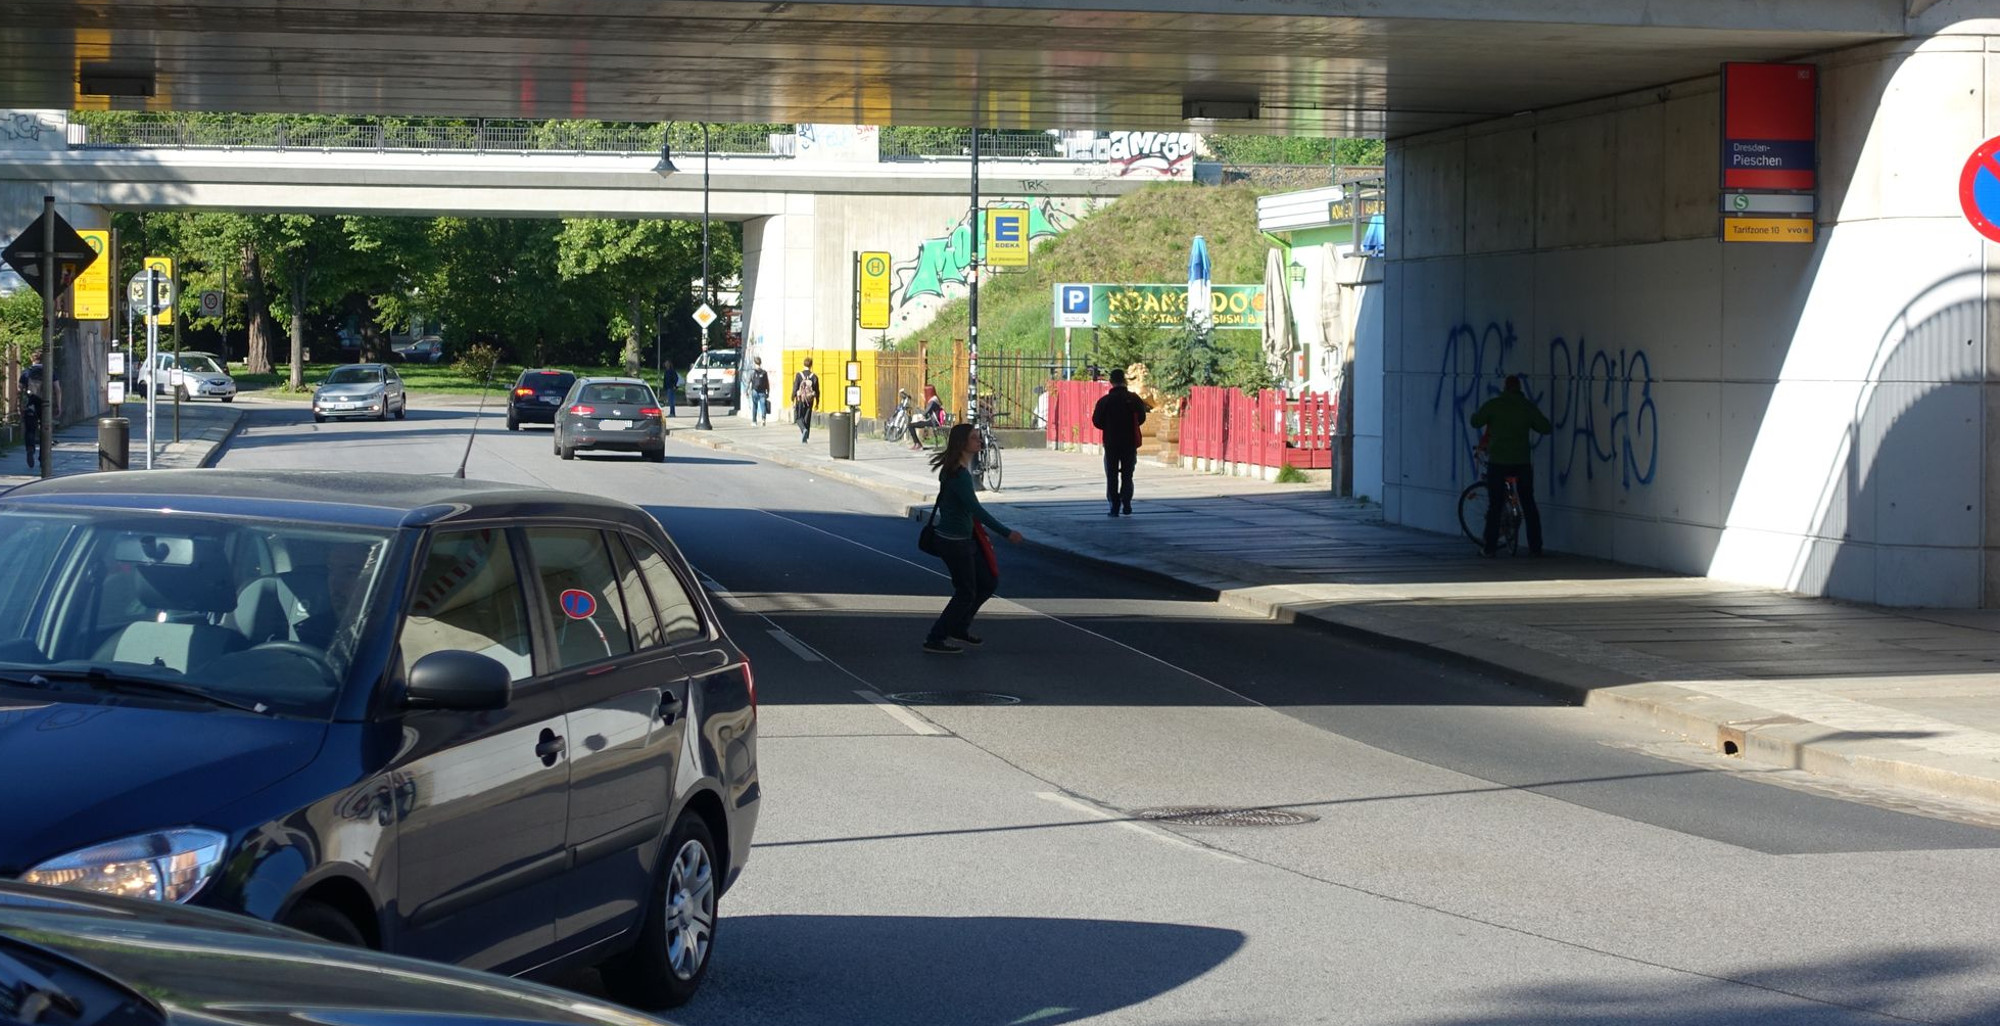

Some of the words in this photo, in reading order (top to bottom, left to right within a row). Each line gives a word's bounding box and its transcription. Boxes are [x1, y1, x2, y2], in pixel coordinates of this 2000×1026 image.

[1733, 143, 1771, 152] Dresden-
[1733, 154, 1782, 167] Pieschen
[1735, 196, 1748, 209] S
[1733, 226, 1769, 235] Tarifzone
[1771, 226, 1780, 235] 10
[1069, 290, 1084, 310] P
